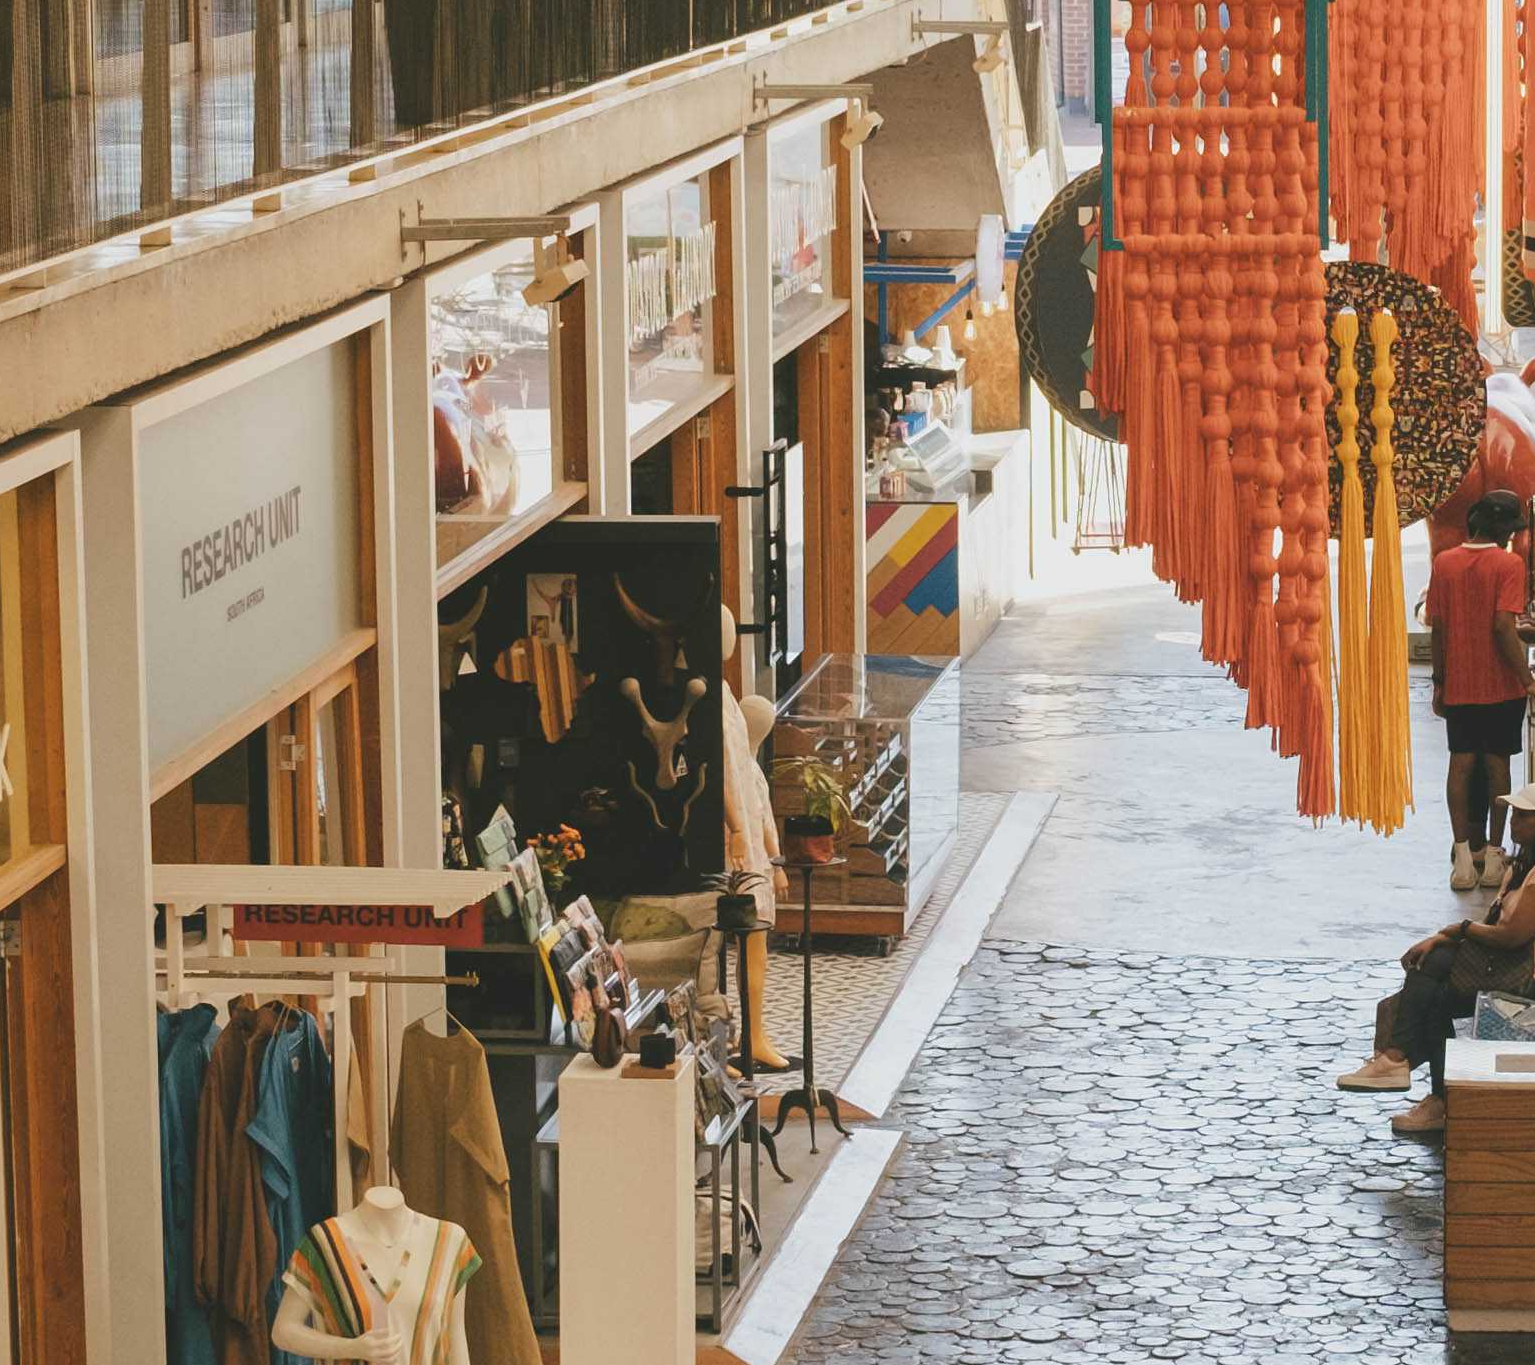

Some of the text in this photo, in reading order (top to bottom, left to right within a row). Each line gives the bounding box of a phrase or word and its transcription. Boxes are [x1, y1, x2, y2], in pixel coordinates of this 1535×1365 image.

[181, 485, 301, 599] RESEARCH UNIT
[243, 905, 394, 927] RESEARCH
